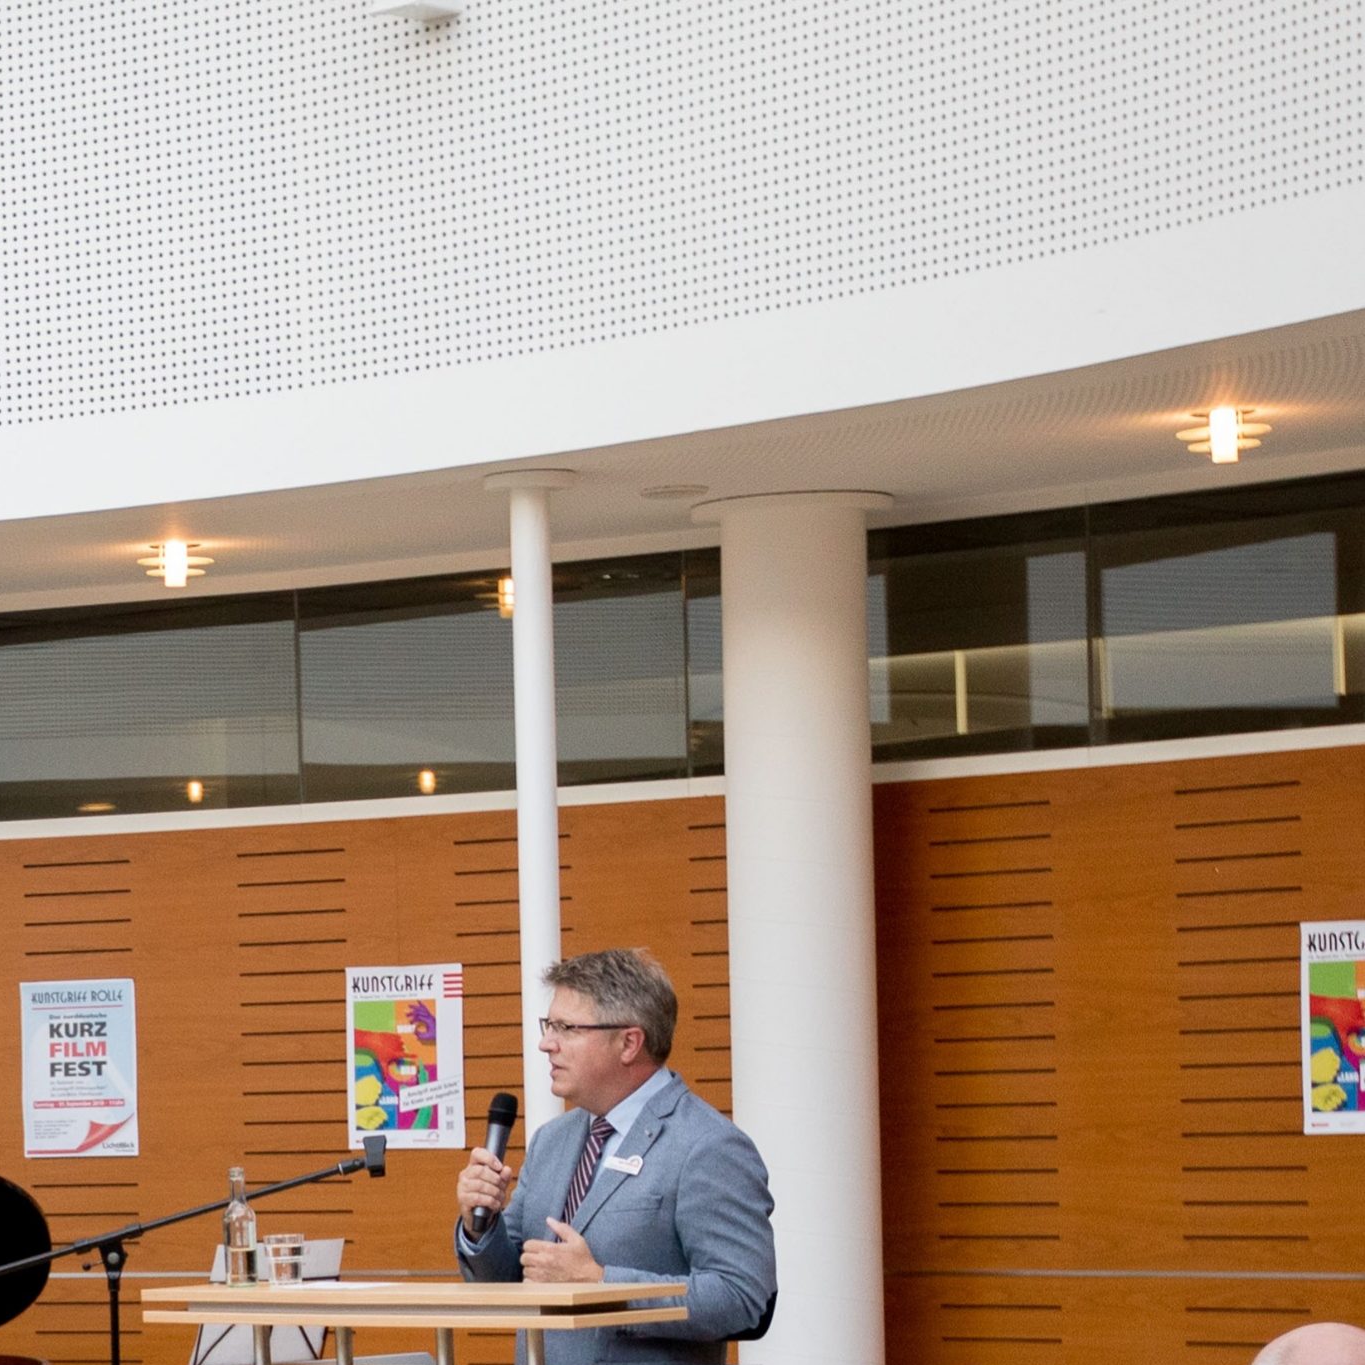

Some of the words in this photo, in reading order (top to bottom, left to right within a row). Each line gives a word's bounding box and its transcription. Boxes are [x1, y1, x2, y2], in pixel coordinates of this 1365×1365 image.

[352, 974, 434, 993] KUNSTGRIFF
[31, 990, 88, 1004] KUNSTGRIFF
[49, 1021, 107, 1038] KURZ
[49, 1041, 107, 1058] FILM
[50, 1061, 107, 1077] FEST
